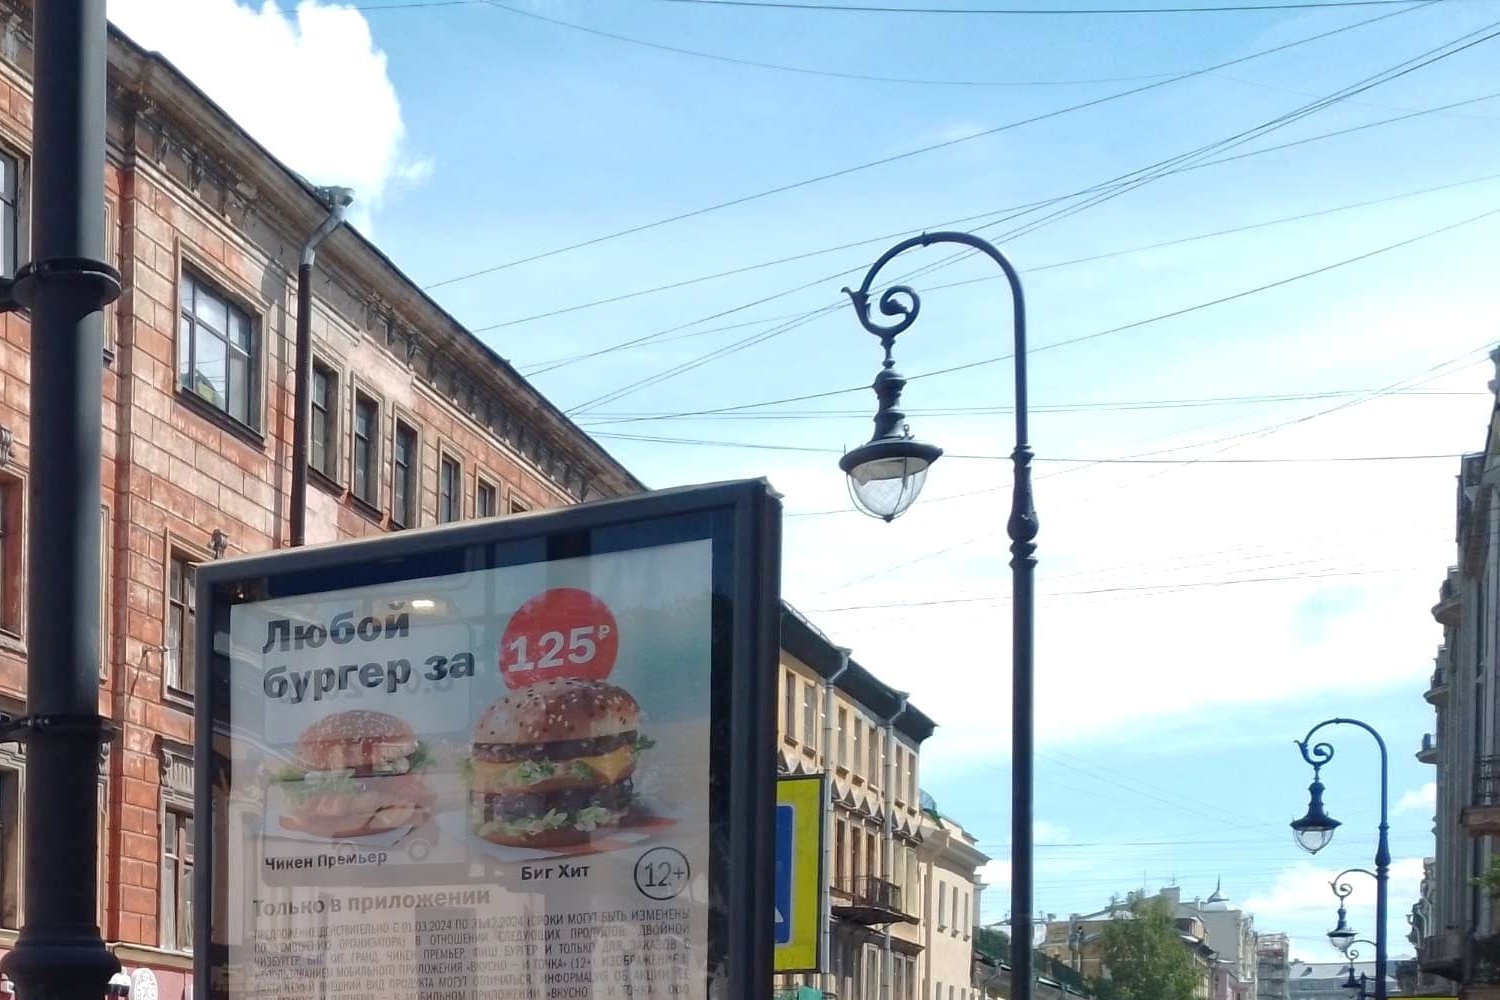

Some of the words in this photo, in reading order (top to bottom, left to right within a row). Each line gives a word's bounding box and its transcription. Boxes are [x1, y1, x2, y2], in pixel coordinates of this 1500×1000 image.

[262, 602, 411, 655] Любой
[263, 655, 412, 705] бургер
[424, 649, 475, 681] за
[265, 856, 313, 872] Чикен
[318, 850, 387, 870] Премьер
[521, 866, 553, 882] Биг
[557, 864, 590, 881] Хит
[644, 862, 685, 888] 12+
[252, 899, 325, 917] Только
[331, 899, 341, 913] в
[348, 888, 490, 915] приложении
[455, 918, 468, 930] ПО
[568, 912, 597, 925] МОГУТ
[602, 911, 627, 922] БЫТЬ
[631, 908, 690, 921] ИЗМЕНЕНЫ
[438, 975, 467, 988] МОГУТ
